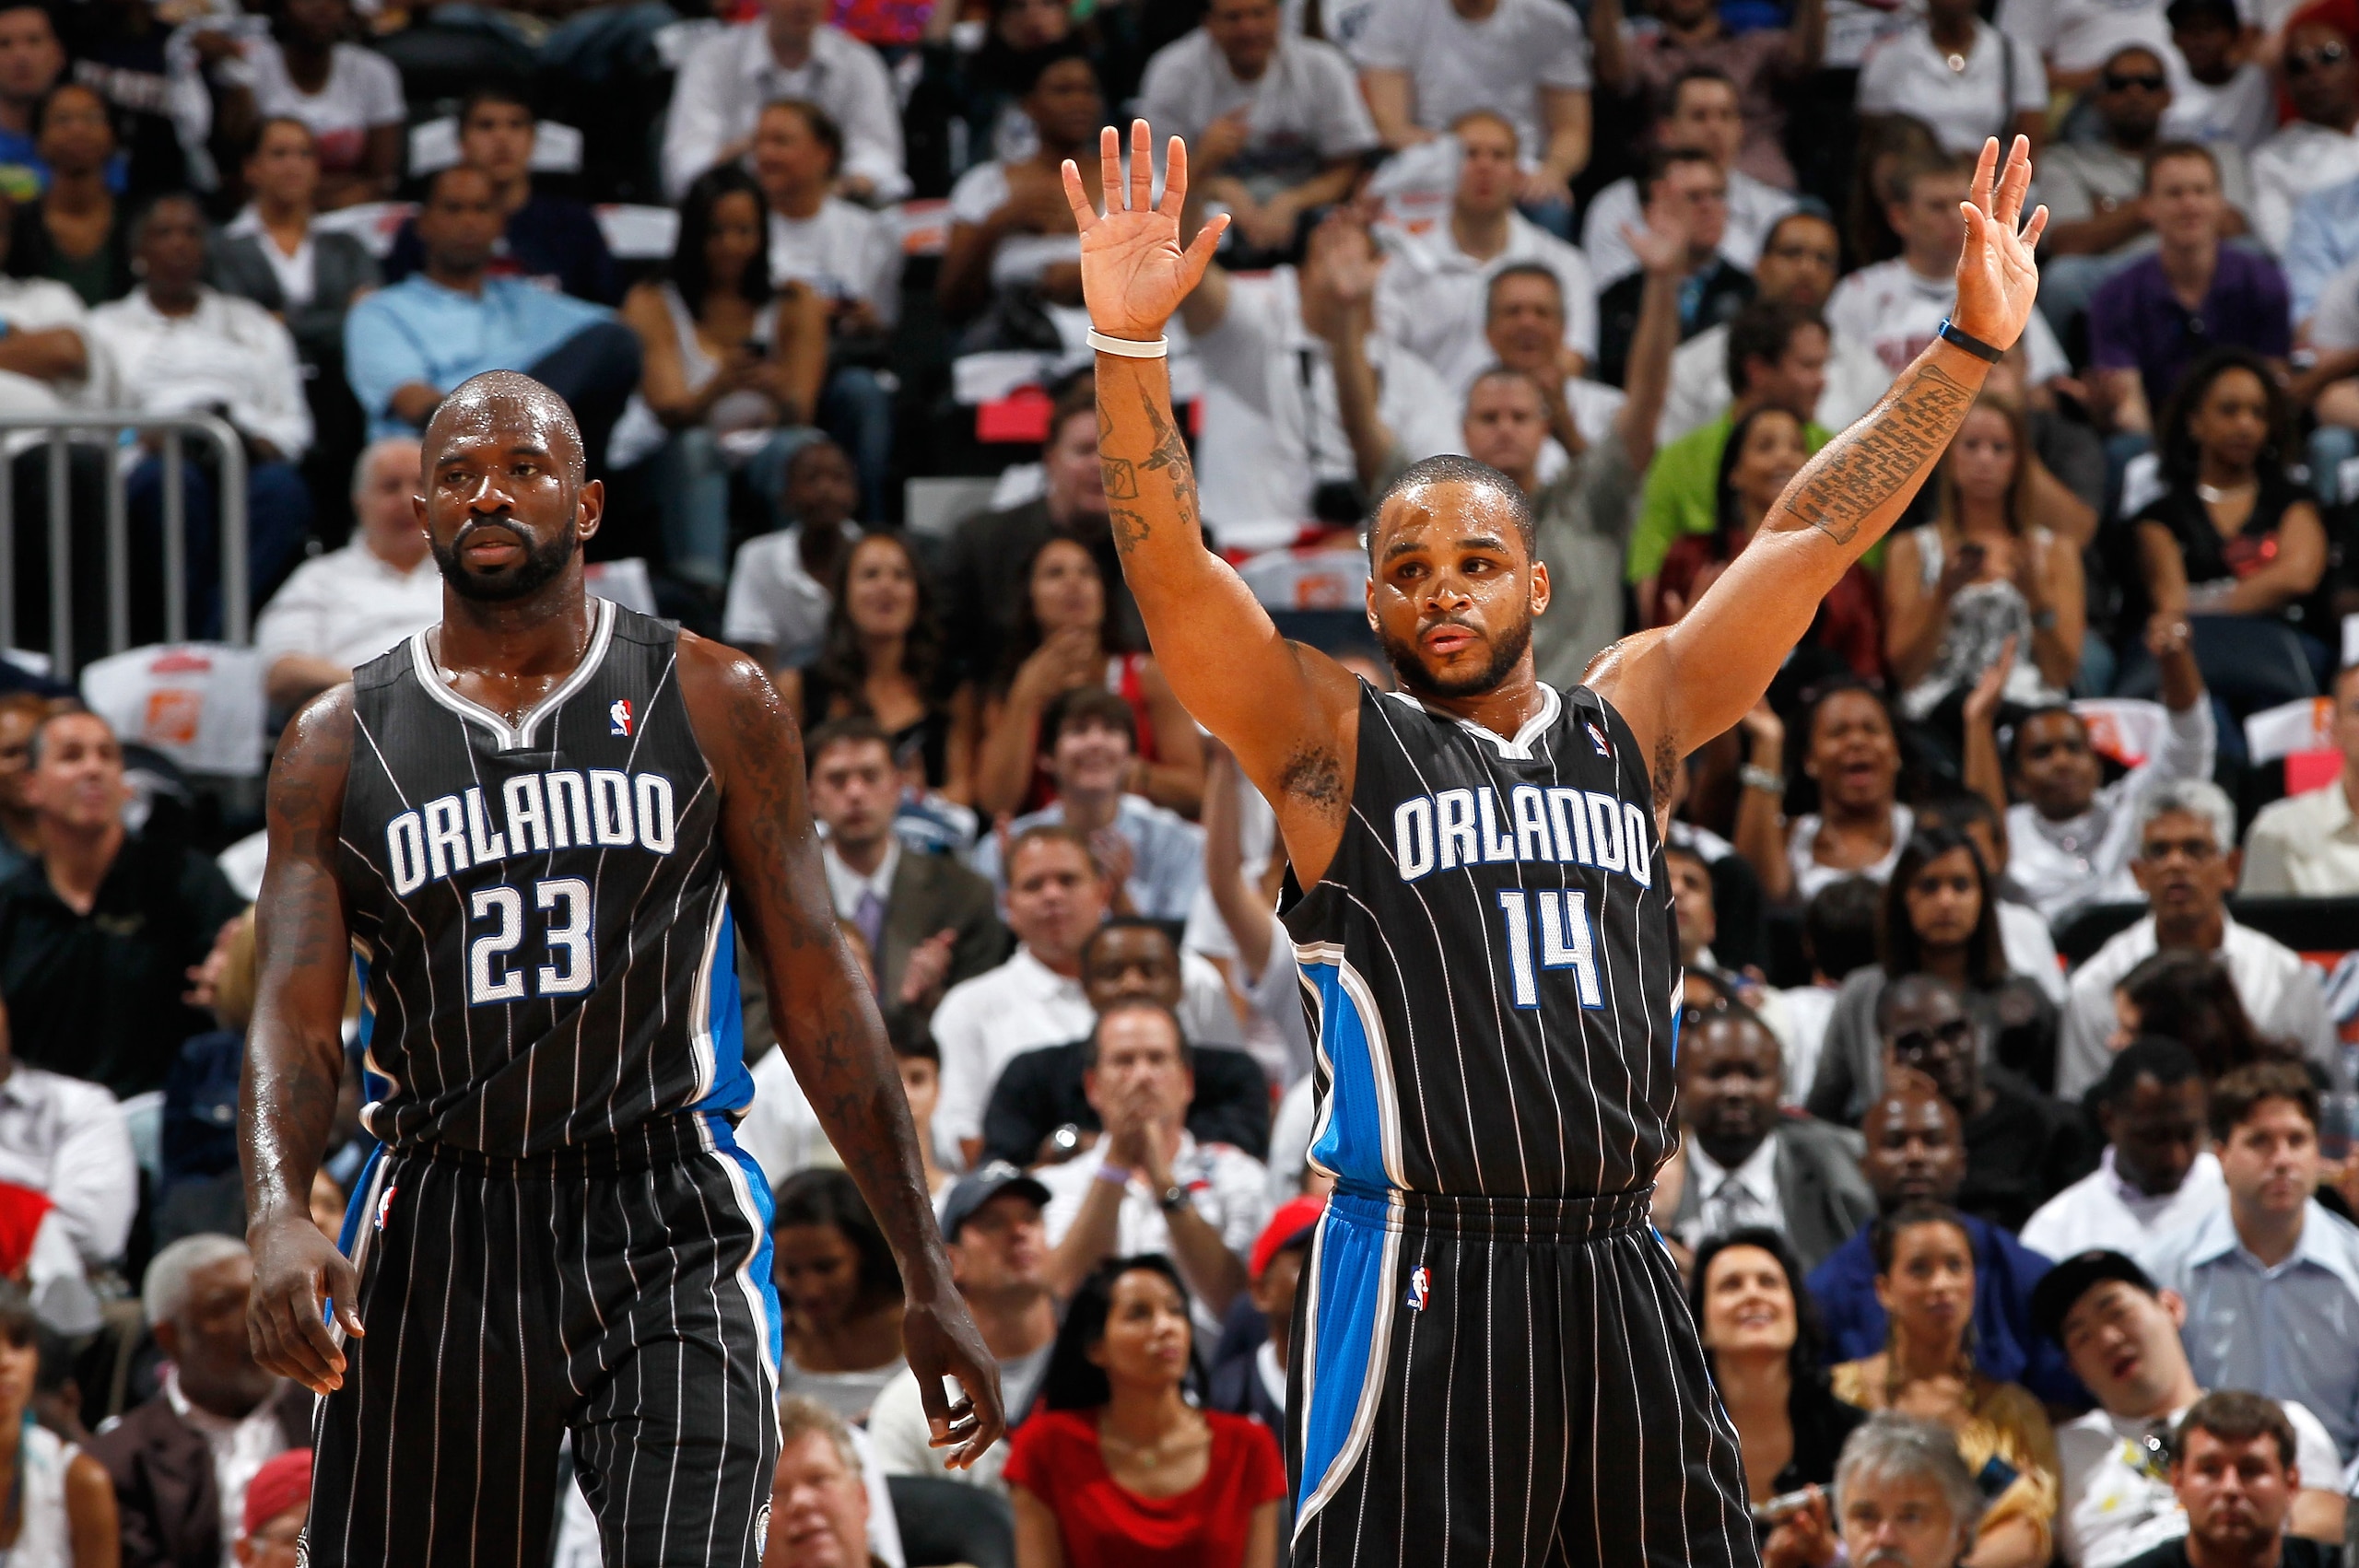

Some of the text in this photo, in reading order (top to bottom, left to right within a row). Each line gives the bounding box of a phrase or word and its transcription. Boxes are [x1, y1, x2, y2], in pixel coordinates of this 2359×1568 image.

[385, 767, 675, 897] ORLANDO
[1393, 784, 1652, 889] ORLANDO
[469, 876, 597, 1006] 23
[1497, 890, 1604, 1009] 14
[1407, 1299, 1420, 1307] NBA
